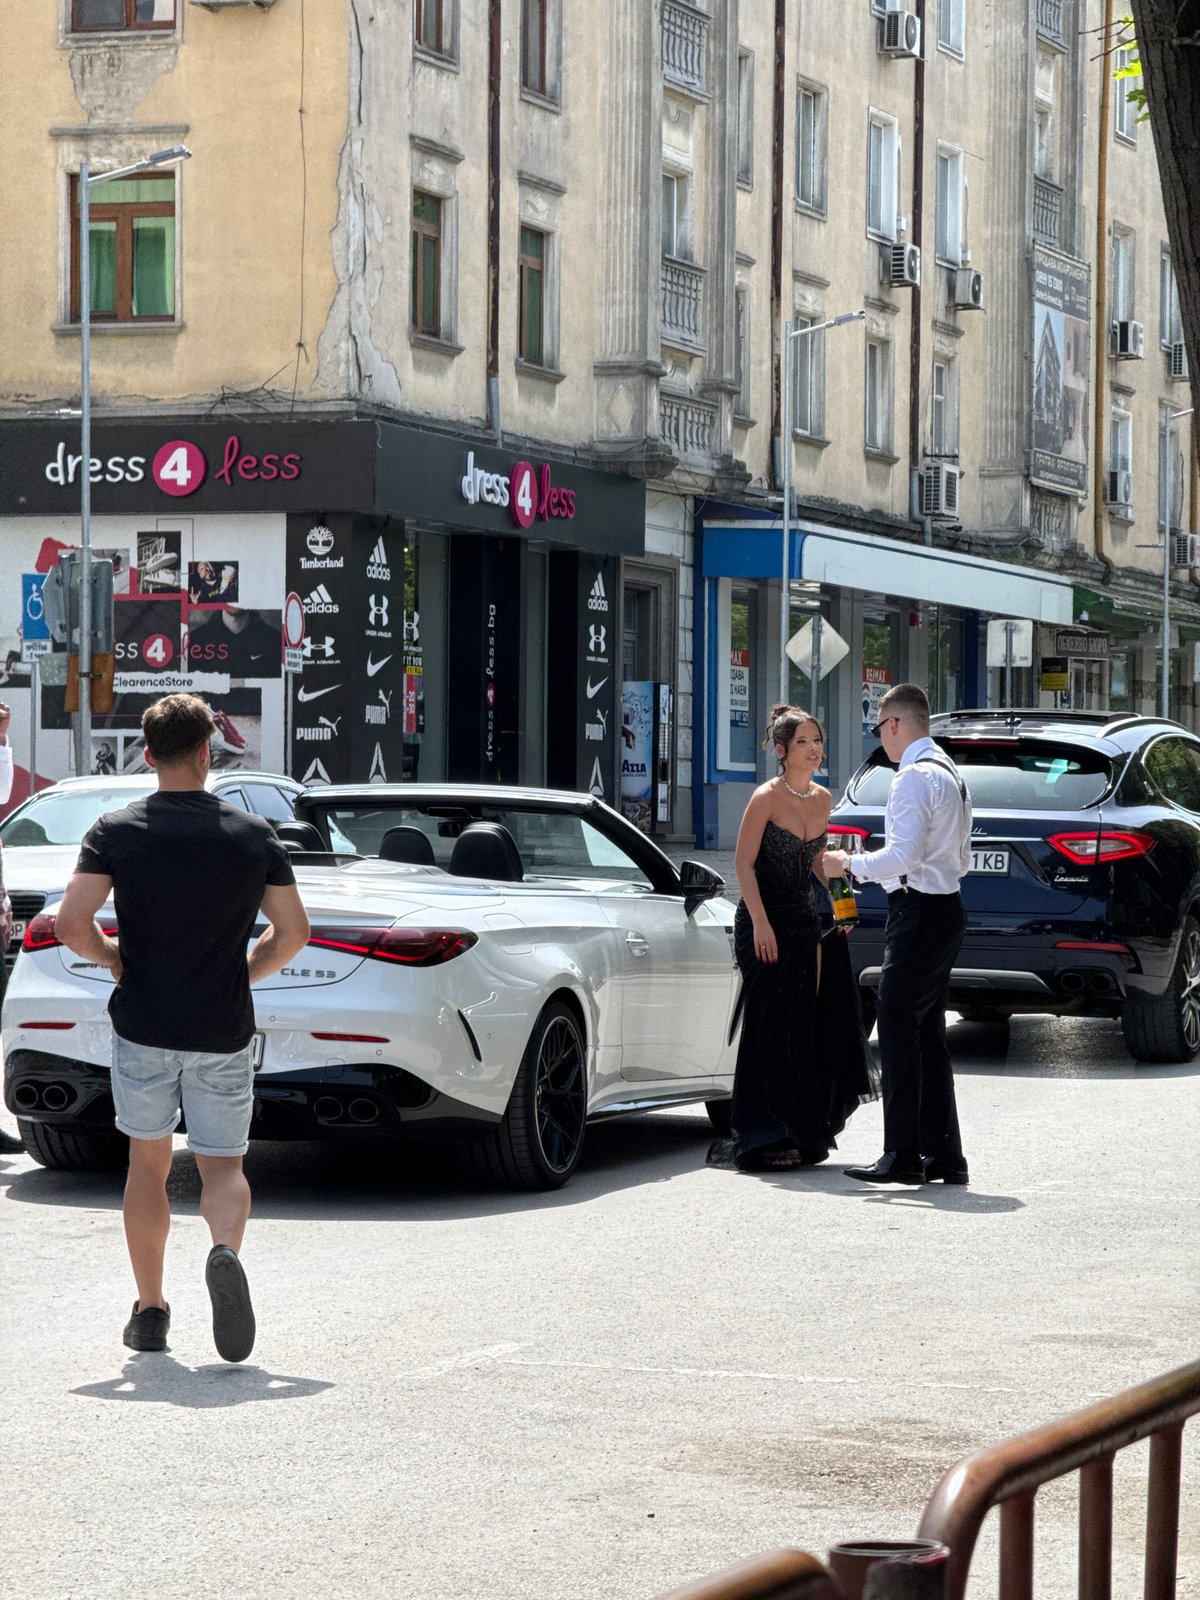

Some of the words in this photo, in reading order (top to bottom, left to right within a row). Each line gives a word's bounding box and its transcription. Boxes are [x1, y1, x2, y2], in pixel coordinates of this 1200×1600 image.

[45, 441, 147, 486] dress
[160, 447, 192, 487] 4
[215, 435, 301, 486] less
[461, 451, 510, 507] dress
[517, 469, 533, 517] 4
[538, 462, 577, 523] less
[300, 556, 344, 569] Timberland
[366, 562, 391, 582] adidas
[588, 595, 609, 612] adidas
[146, 637, 166, 662] 4
[177, 631, 229, 661] less
[365, 705, 386, 725] PUMA
[296, 727, 332, 740] PUMA
[585, 723, 603, 741] PUMA
[972, 852, 1005, 870] 1KB
[280, 967, 311, 977] CLE
[315, 970, 336, 979] 53
